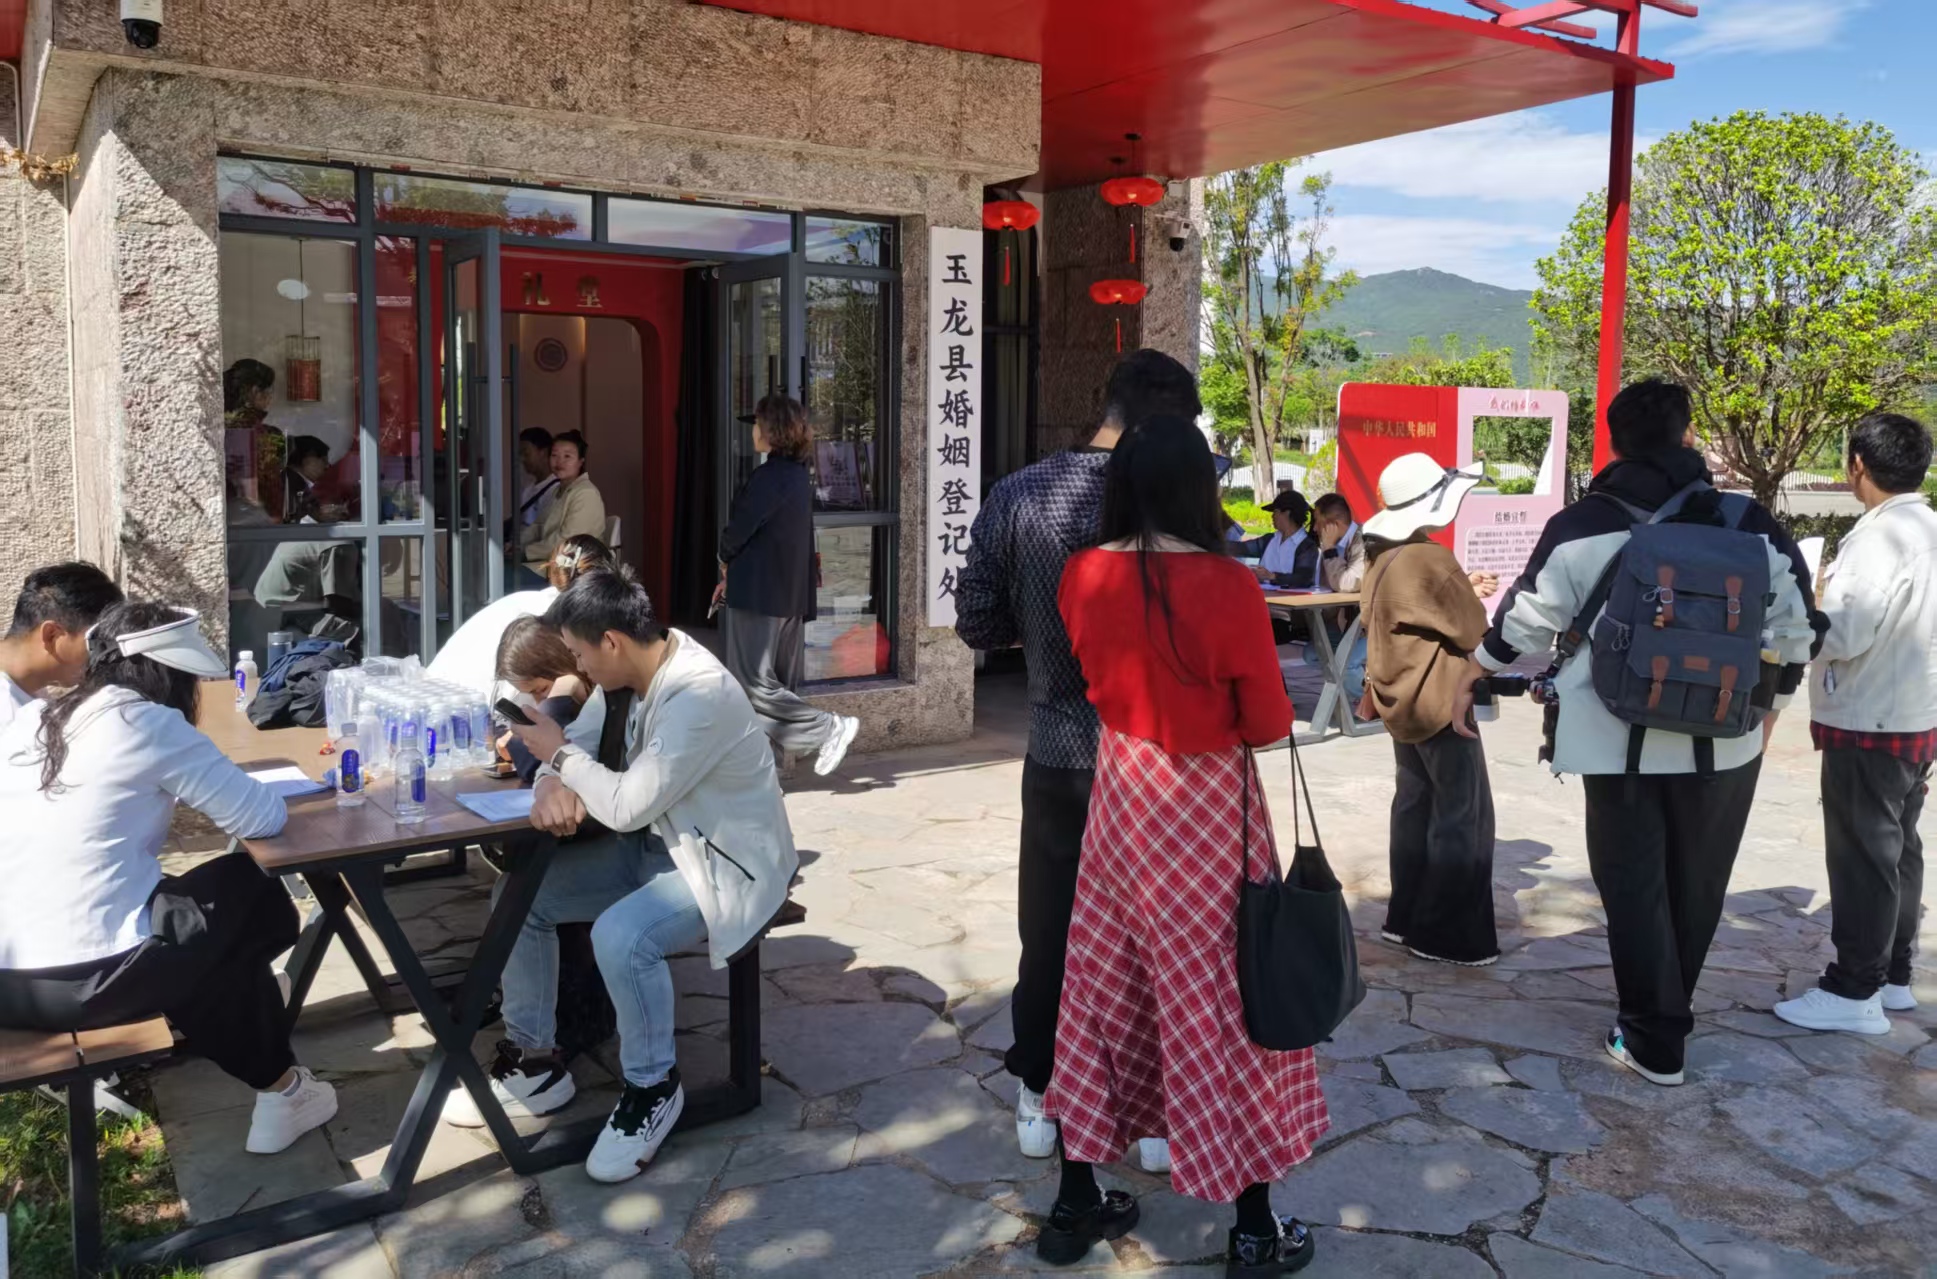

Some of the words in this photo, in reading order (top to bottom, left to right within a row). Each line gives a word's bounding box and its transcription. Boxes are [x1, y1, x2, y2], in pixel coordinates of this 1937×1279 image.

[938, 254, 974, 600] 玉龙县婚姻登记处
[1362, 419, 1437, 438] 中华人民共和国
